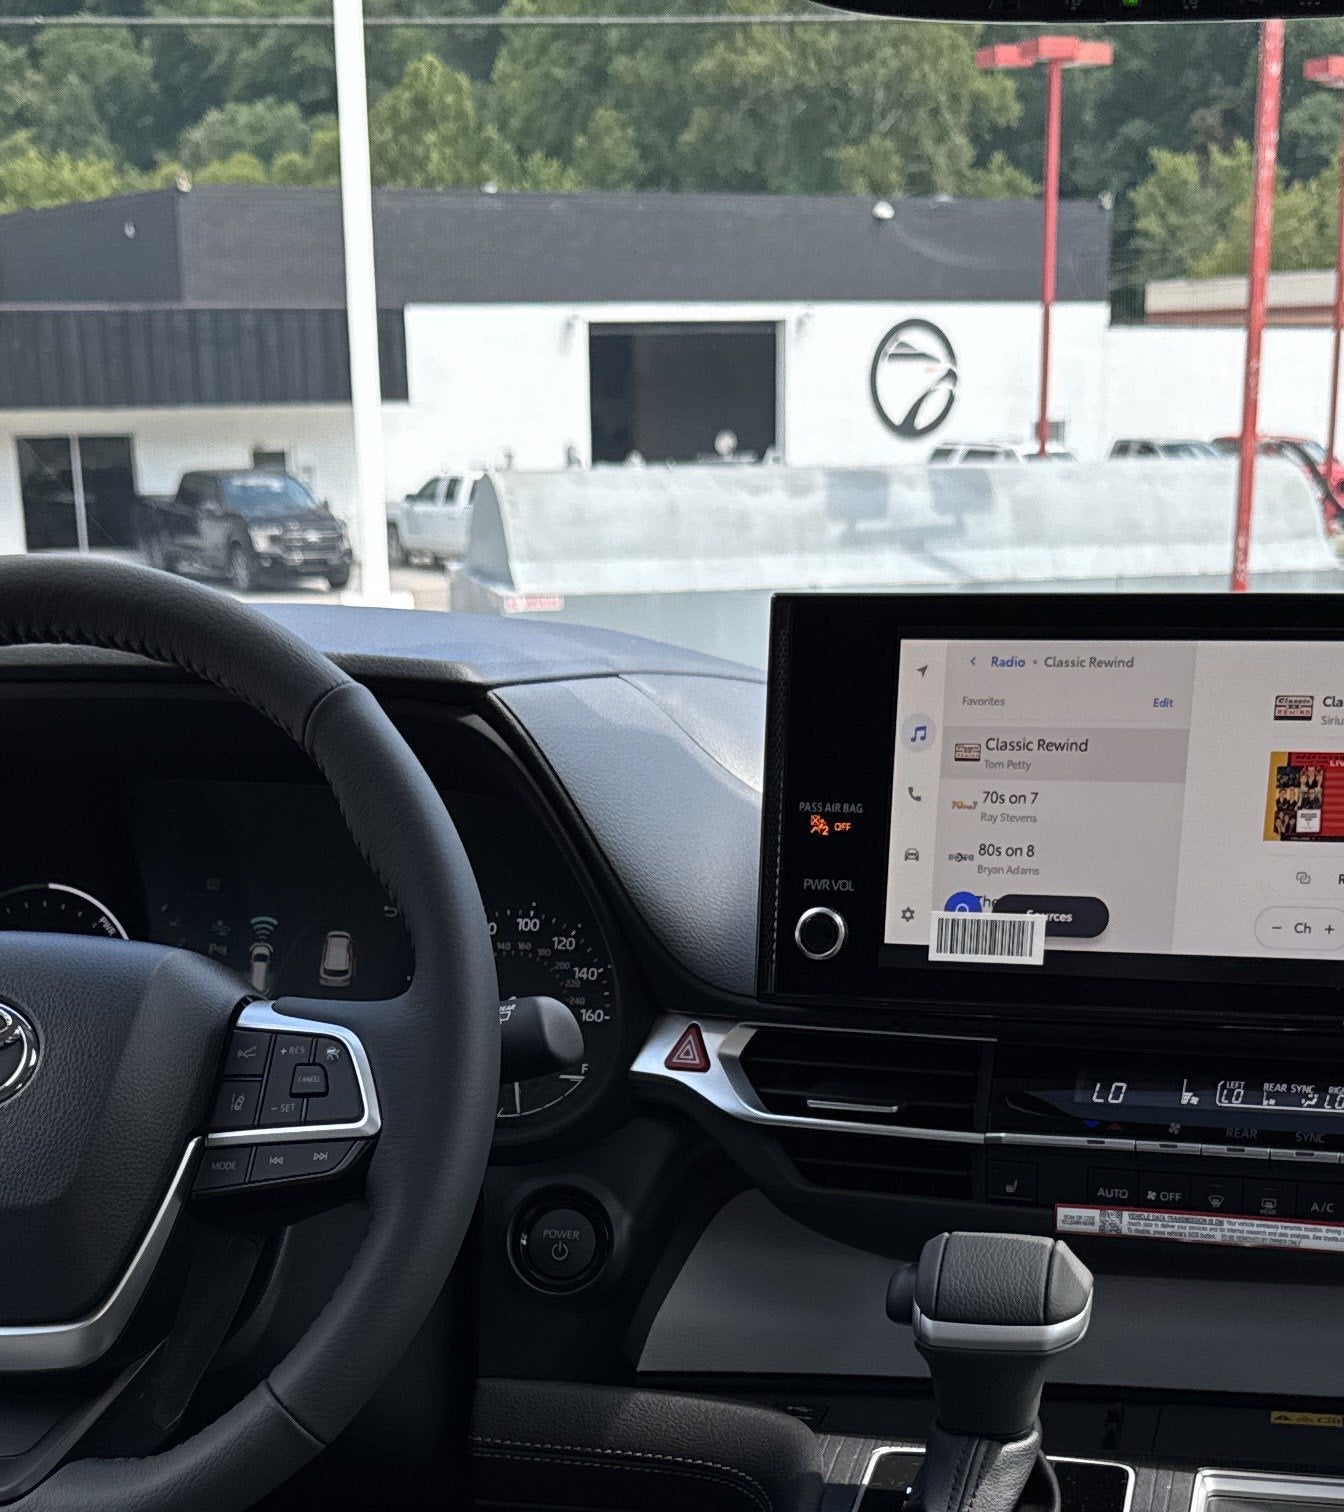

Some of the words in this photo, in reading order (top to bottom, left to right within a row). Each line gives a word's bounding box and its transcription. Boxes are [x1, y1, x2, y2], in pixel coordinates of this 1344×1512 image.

[991, 656, 1025, 668] Radio
[1044, 656, 1086, 669] Classic
[1089, 656, 1134, 669] Rewind
[962, 697, 1005, 707] Favorites
[1152, 697, 1173, 708] Edit
[986, 738, 1034, 752] Classic
[1037, 738, 1089, 753] Rewind
[984, 759, 1005, 770] Tom
[1007, 759, 1031, 772] Petty
[982, 791, 1004, 804] 70s
[1009, 794, 1027, 804] on
[1031, 792, 1038, 805] 7
[799, 801, 823, 813] PASS
[824, 803, 841, 813] AIR
[843, 803, 863, 814] BAG
[981, 812, 998, 824] Ray
[1000, 813, 1037, 823] Stevens
[835, 822, 851, 831] OFF
[978, 844, 1002, 857] 80s
[1006, 847, 1023, 857] on
[1026, 845, 1035, 858] 8
[977, 865, 1004, 877] Bryan
[1006, 865, 1039, 875] Adams
[804, 879, 830, 890] PWR
[831, 879, 854, 891] VOL
[516, 918, 540, 931] 100
[1294, 922, 1312, 934] Ch
[552, 937, 575, 950] 120
[574, 967, 597, 980] 140
[580, 1009, 604, 1022] 160
[582, 1063, 588, 1073] F
[1226, 1081, 1245, 1089] LEFT
[1264, 1083, 1287, 1092] REAR
[1291, 1084, 1316, 1093] SYNC
[1093, 1083, 1127, 1104] LO
[1221, 1088, 1244, 1103] LO
[280, 1104, 295, 1112] SET
[1226, 1128, 1257, 1139] REAR
[1295, 1133, 1326, 1144] SYNC
[211, 1162, 237, 1170] MODE
[1097, 1188, 1129, 1199] AUTO
[1160, 1192, 1181, 1201] OFF
[1311, 1203, 1334, 1213] A/C
[543, 1229, 580, 1239] POWER
